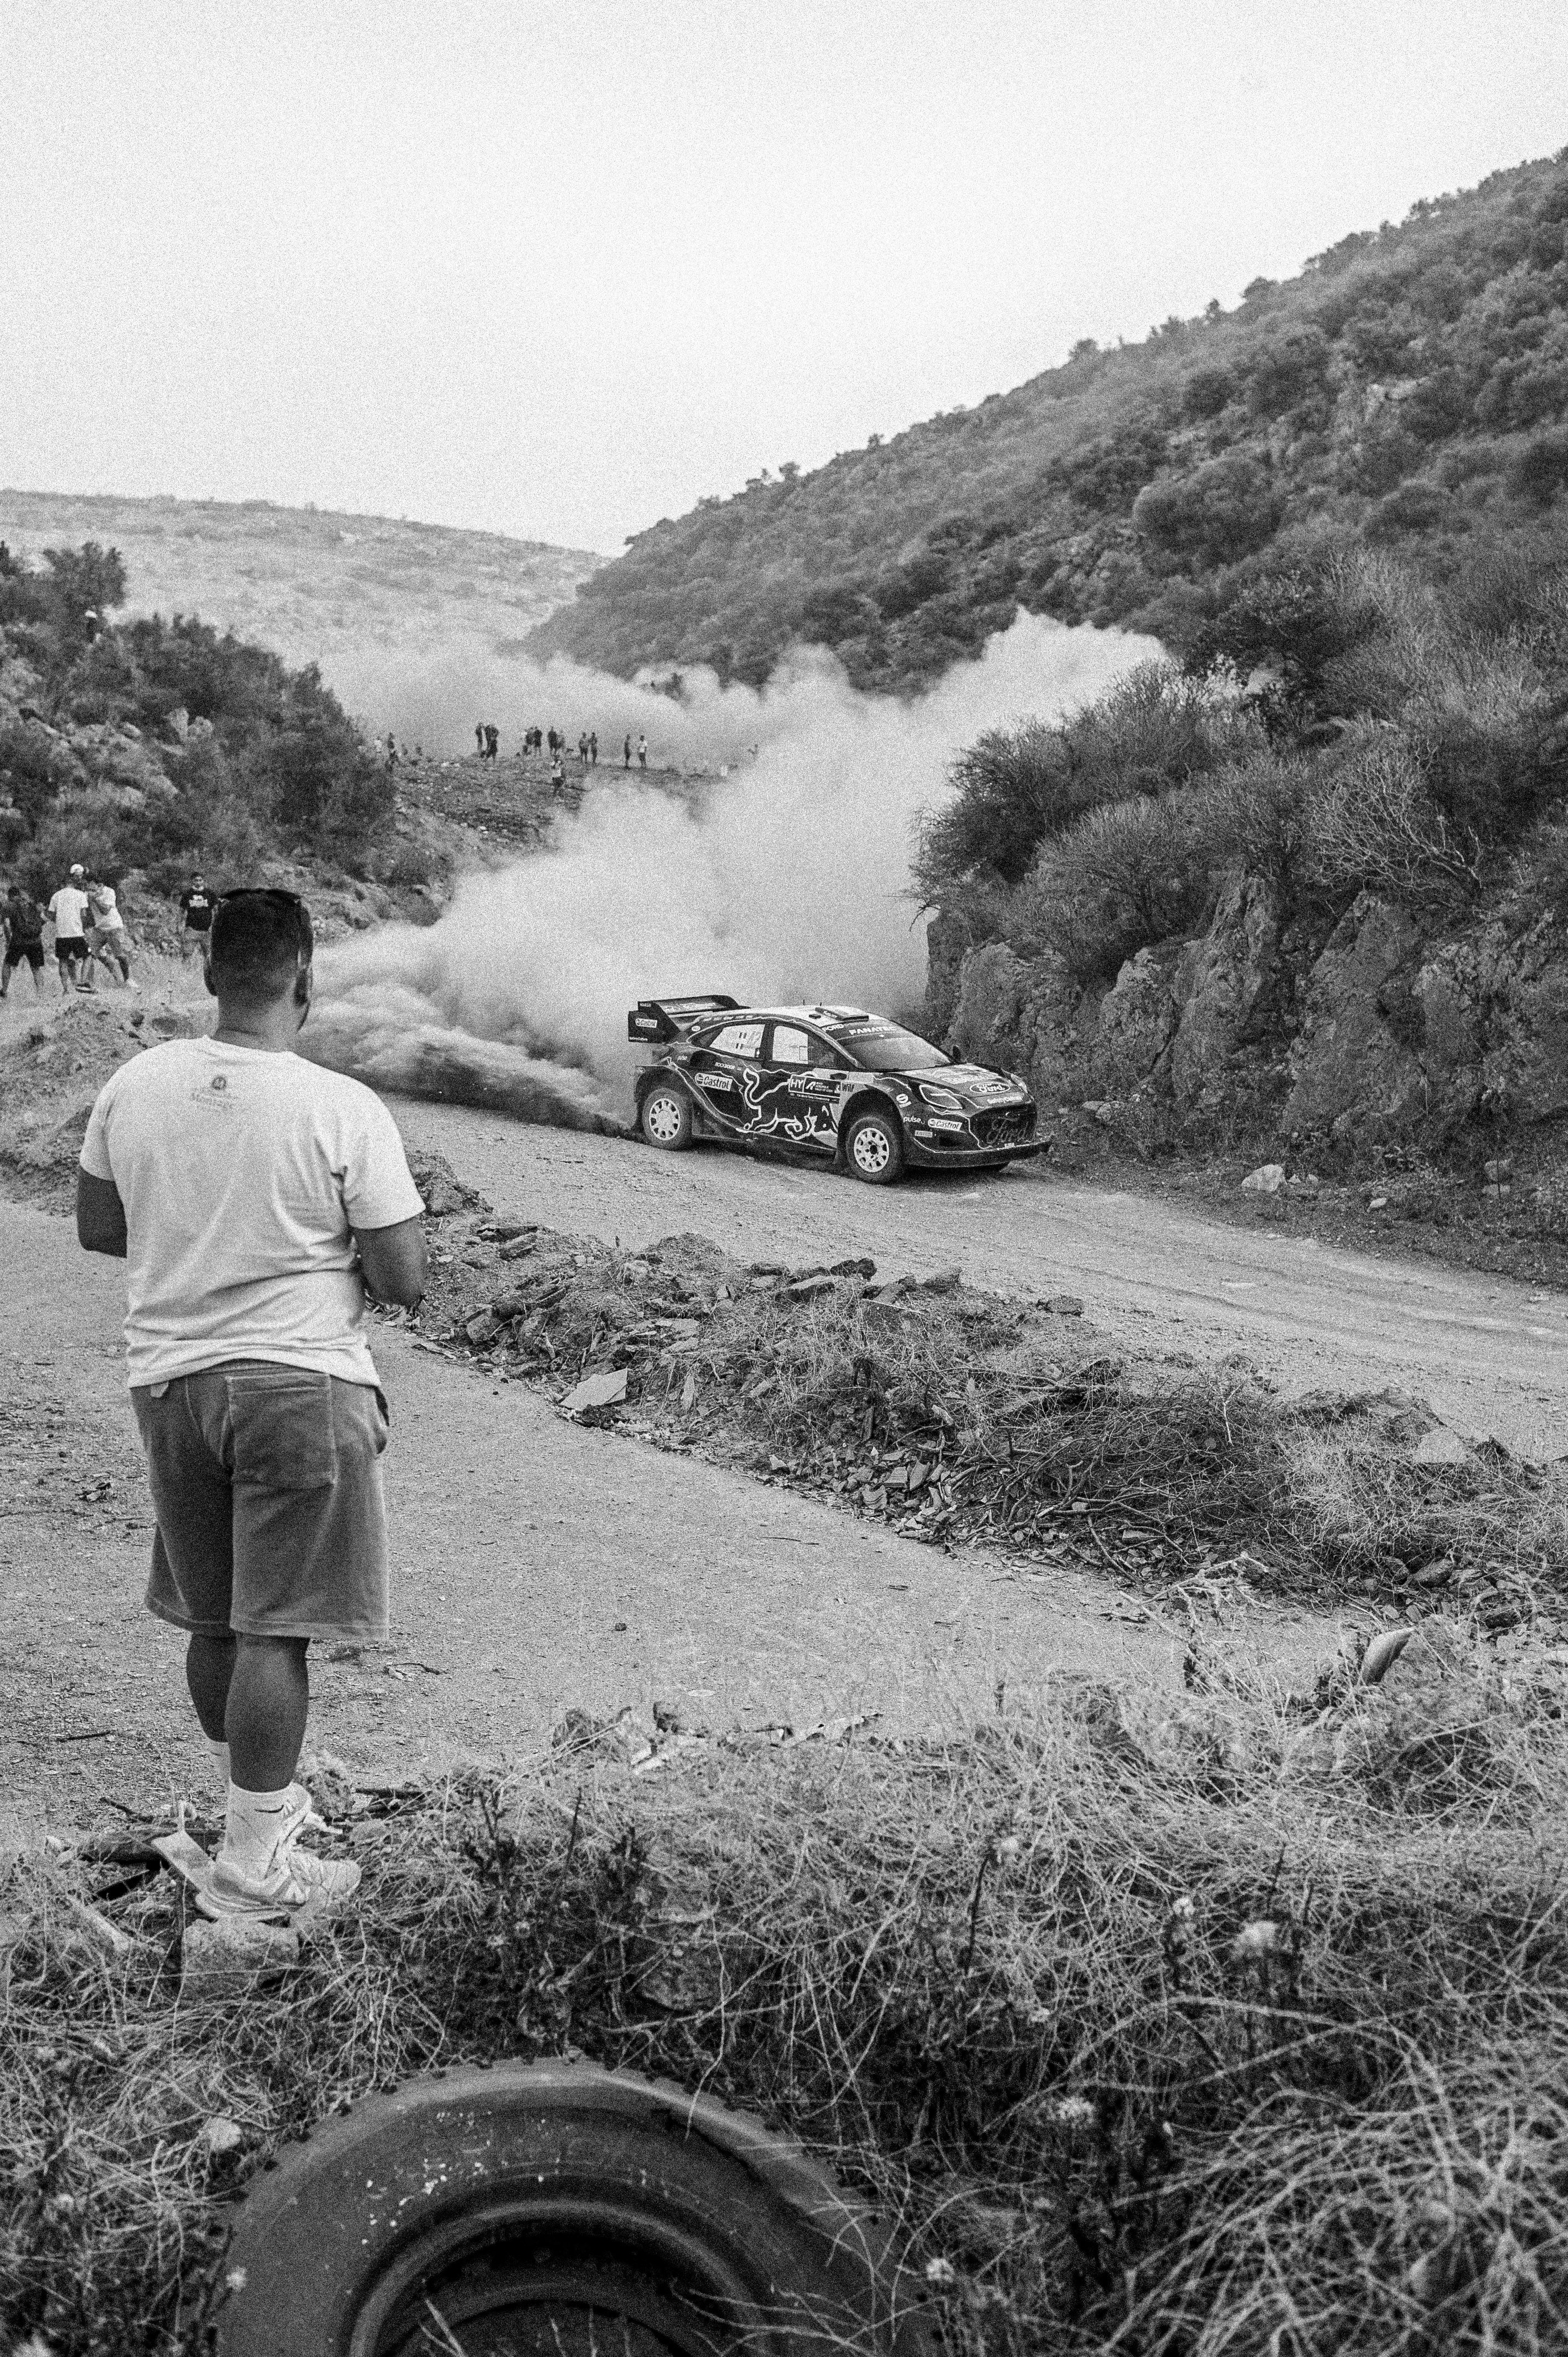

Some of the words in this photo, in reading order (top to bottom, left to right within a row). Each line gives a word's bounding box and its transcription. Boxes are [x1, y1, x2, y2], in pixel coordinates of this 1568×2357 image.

[849, 1026, 896, 1035] FANATEC
[703, 1076, 730, 1089] Castrol
[791, 1079, 804, 1089] HY
[977, 1083, 1005, 1093] Ford
[936, 1121, 960, 1130] Castrol
[987, 1115, 1029, 1144] Ford
